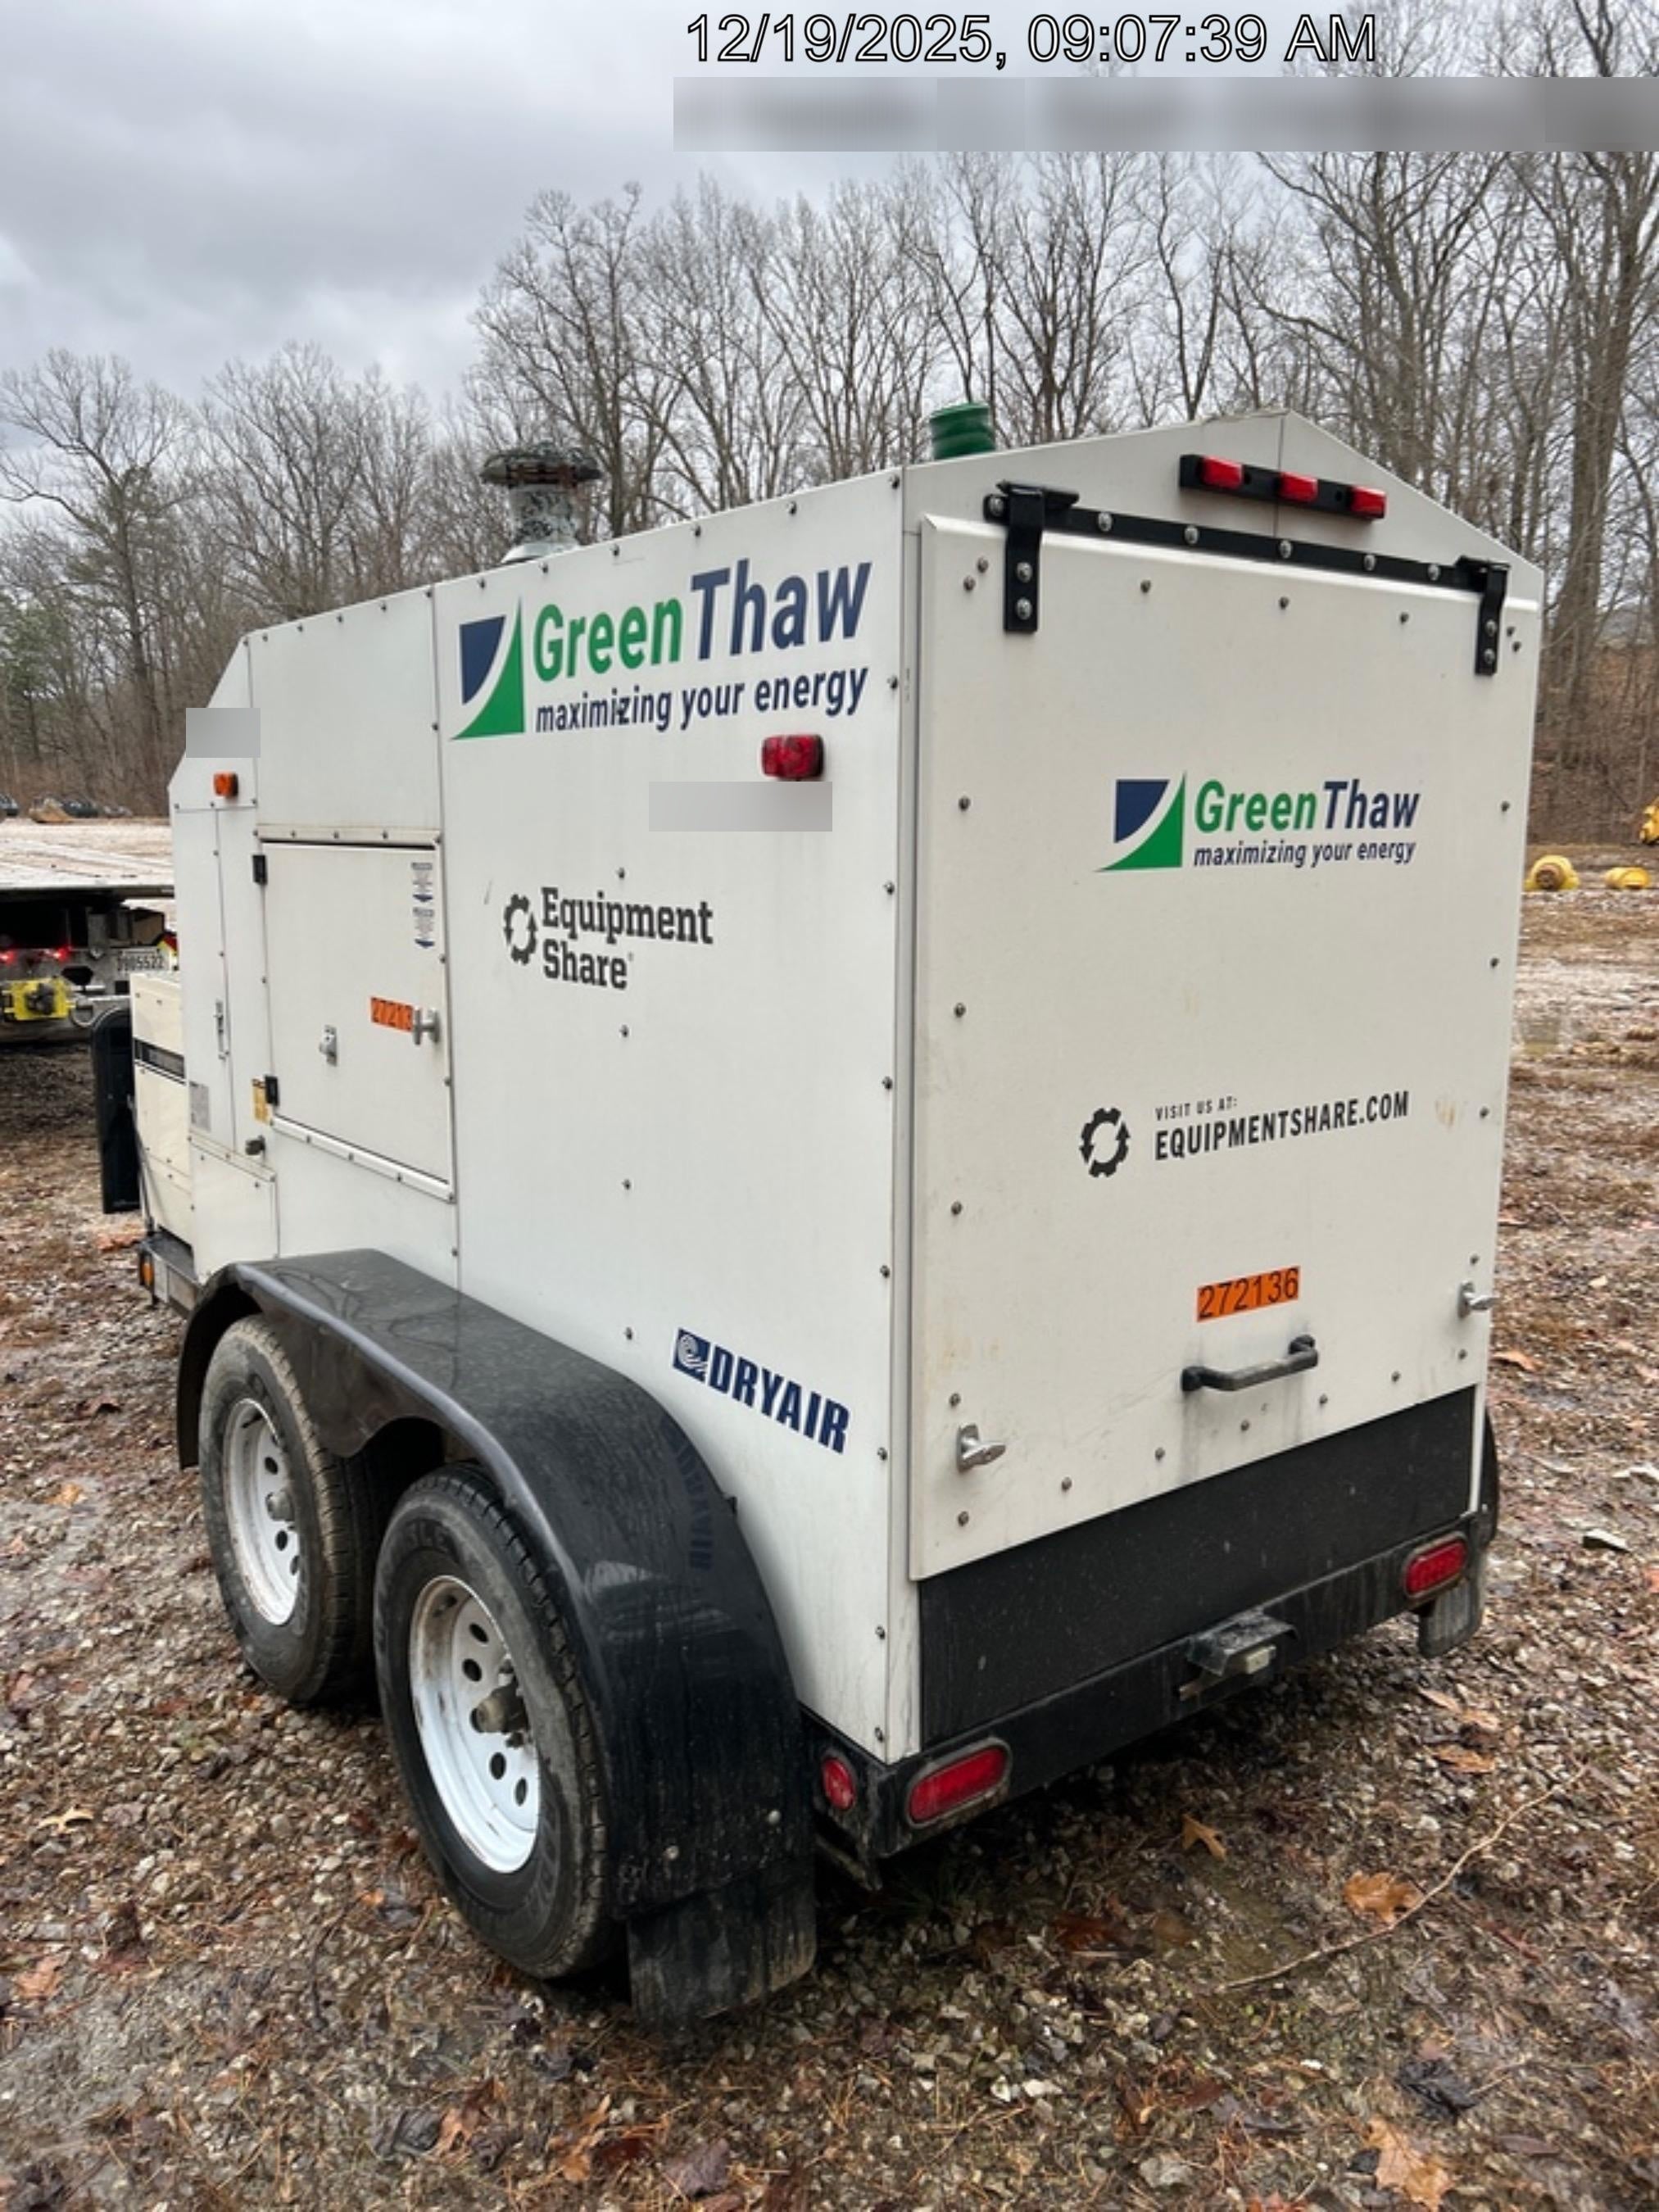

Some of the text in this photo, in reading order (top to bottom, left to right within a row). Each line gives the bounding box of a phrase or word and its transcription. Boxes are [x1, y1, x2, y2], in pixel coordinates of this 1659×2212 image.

[536, 685, 673, 732] maximizing
[680, 681, 745, 731] your
[754, 667, 869, 717] energy
[1194, 840, 1417, 868] maximizing your energy
[541, 886, 714, 944] Equipment
[1155, 1095, 1237, 1121] VISIT US AT:
[1155, 1090, 1409, 1161] EQUIPMENTSHARE.COM
[1197, 1267, 1299, 1320] 272136
[708, 1344, 850, 1455] DRYAIR
